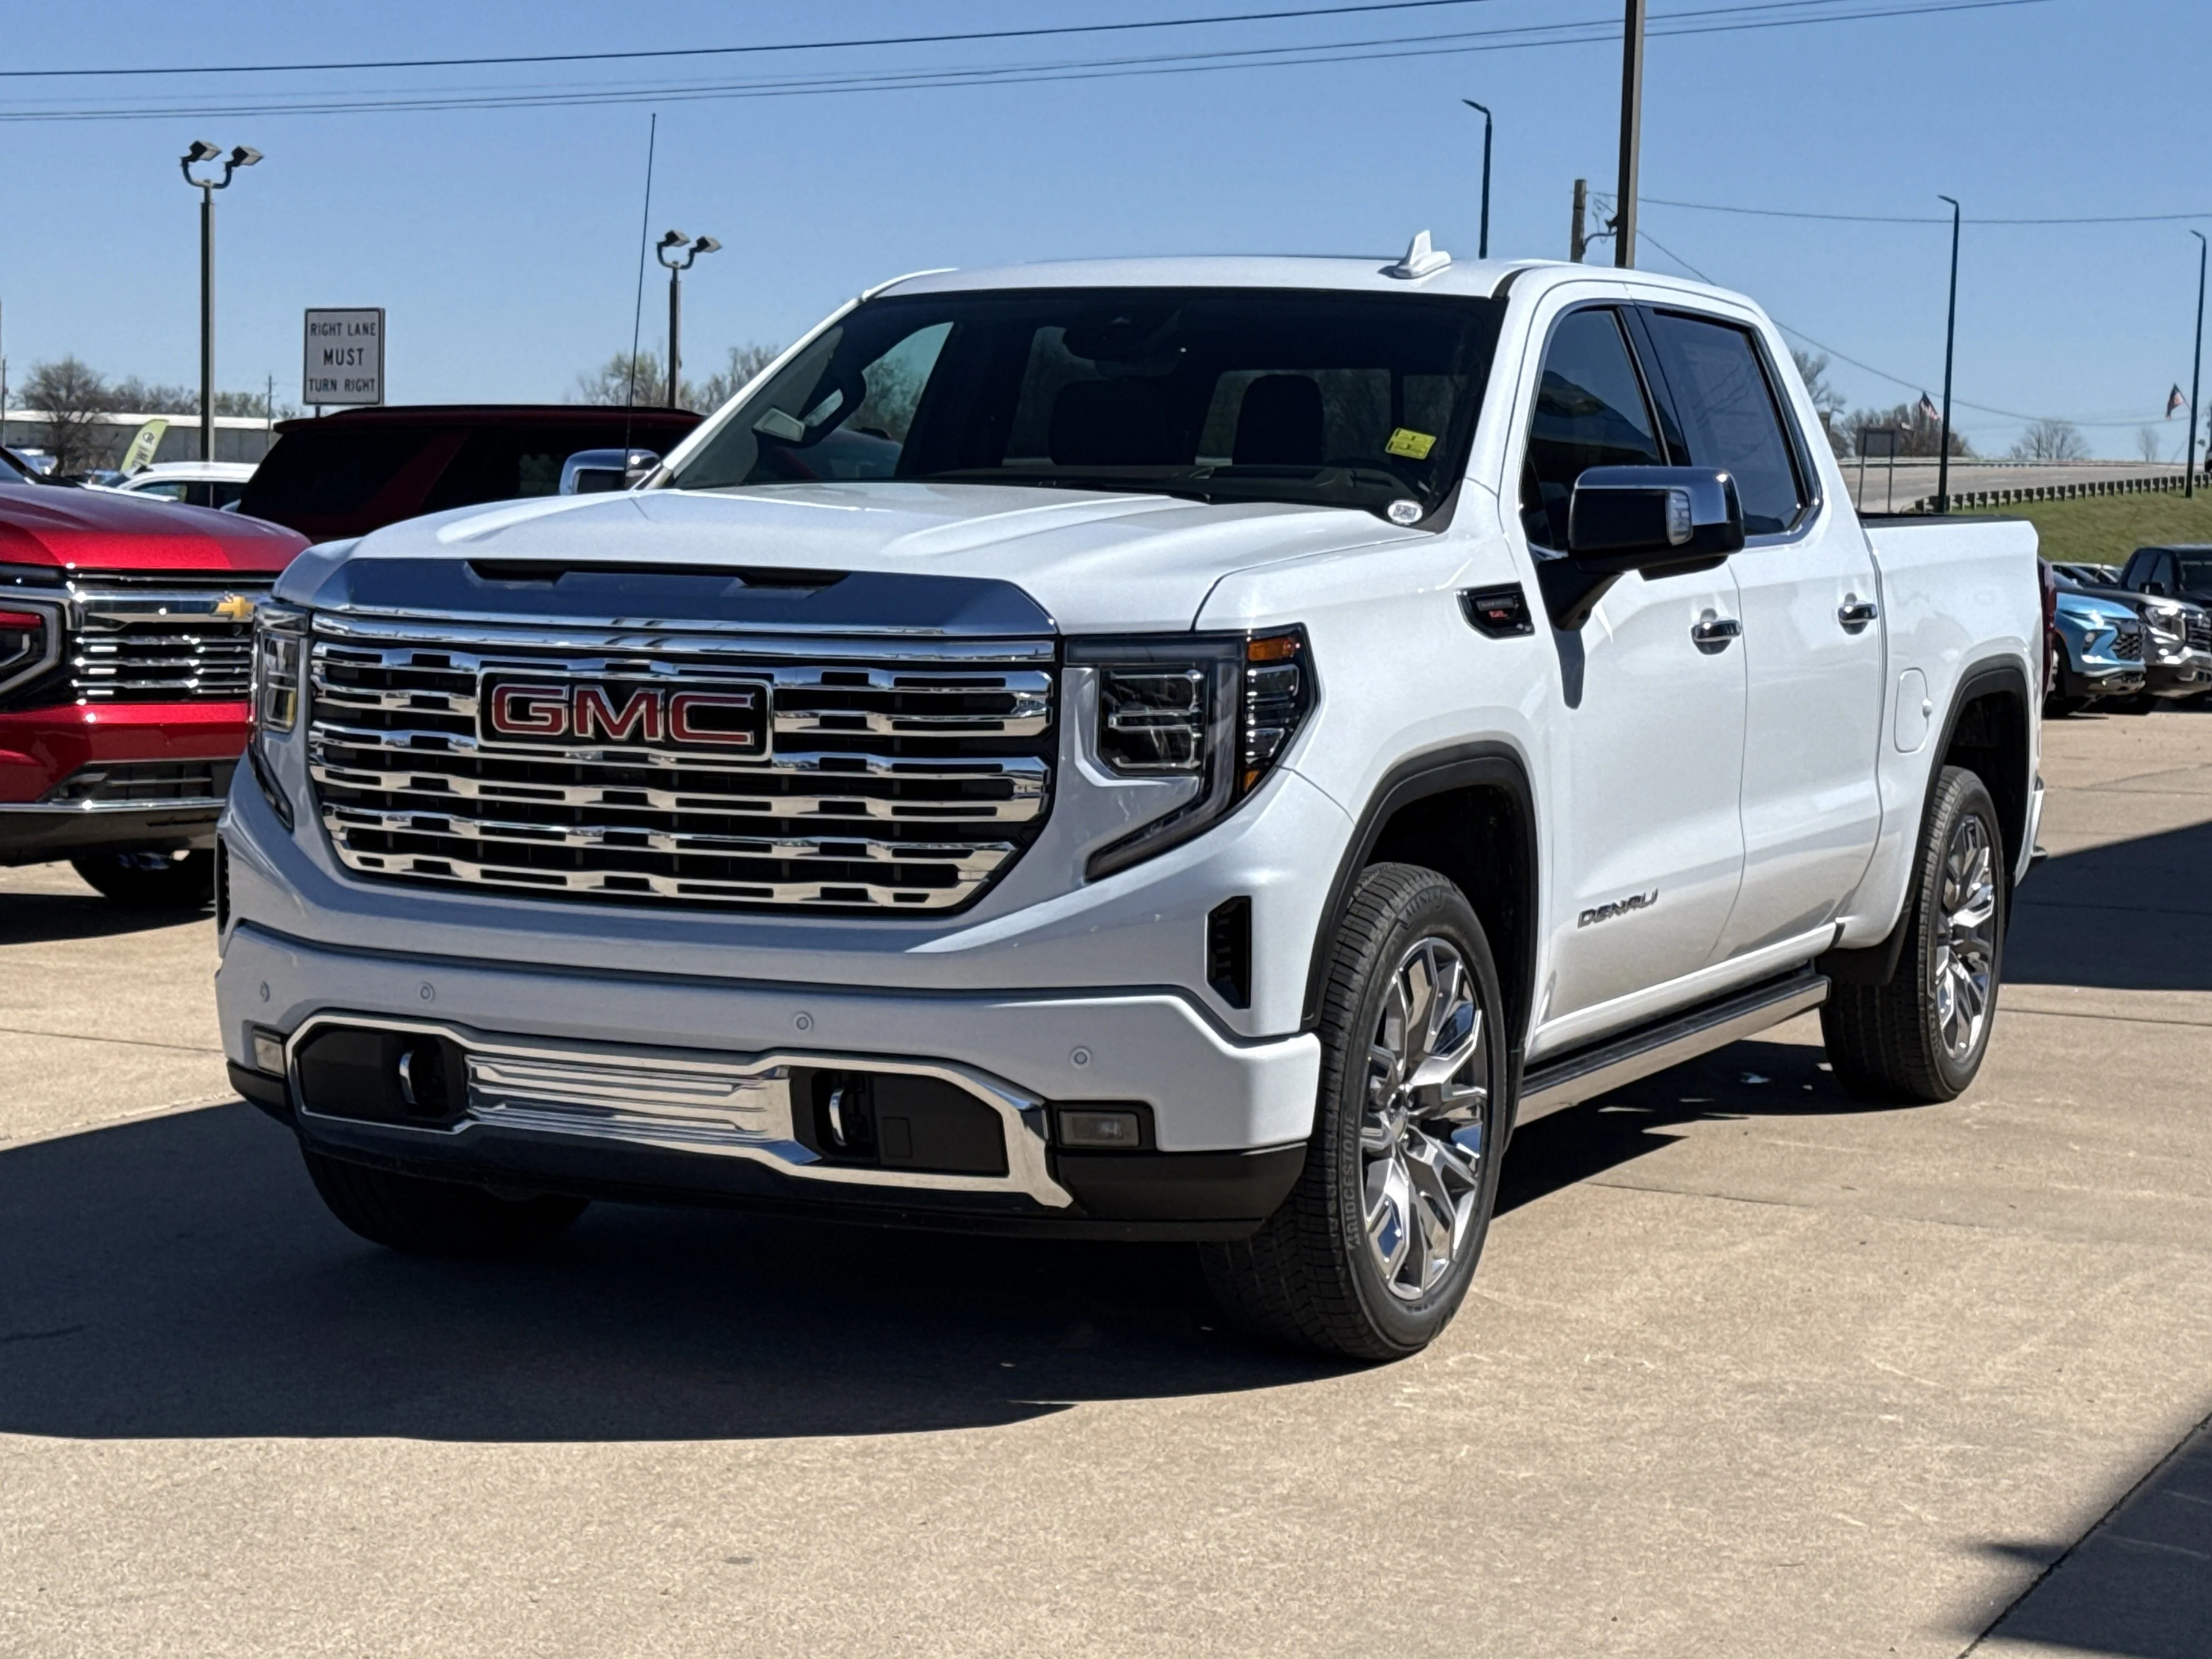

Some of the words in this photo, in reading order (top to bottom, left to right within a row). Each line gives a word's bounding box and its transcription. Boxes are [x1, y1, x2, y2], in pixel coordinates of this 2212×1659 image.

[310, 323, 342, 337] RIGHT
[347, 323, 376, 336] LANE
[323, 348, 364, 366] MUST
[308, 378, 337, 392] TURN
[345, 379, 375, 393] RIGHT
[492, 683, 755, 746] GMC
[1577, 887, 1658, 929] DENALI
[1342, 1110, 1361, 1250] BRIDGESTONE
